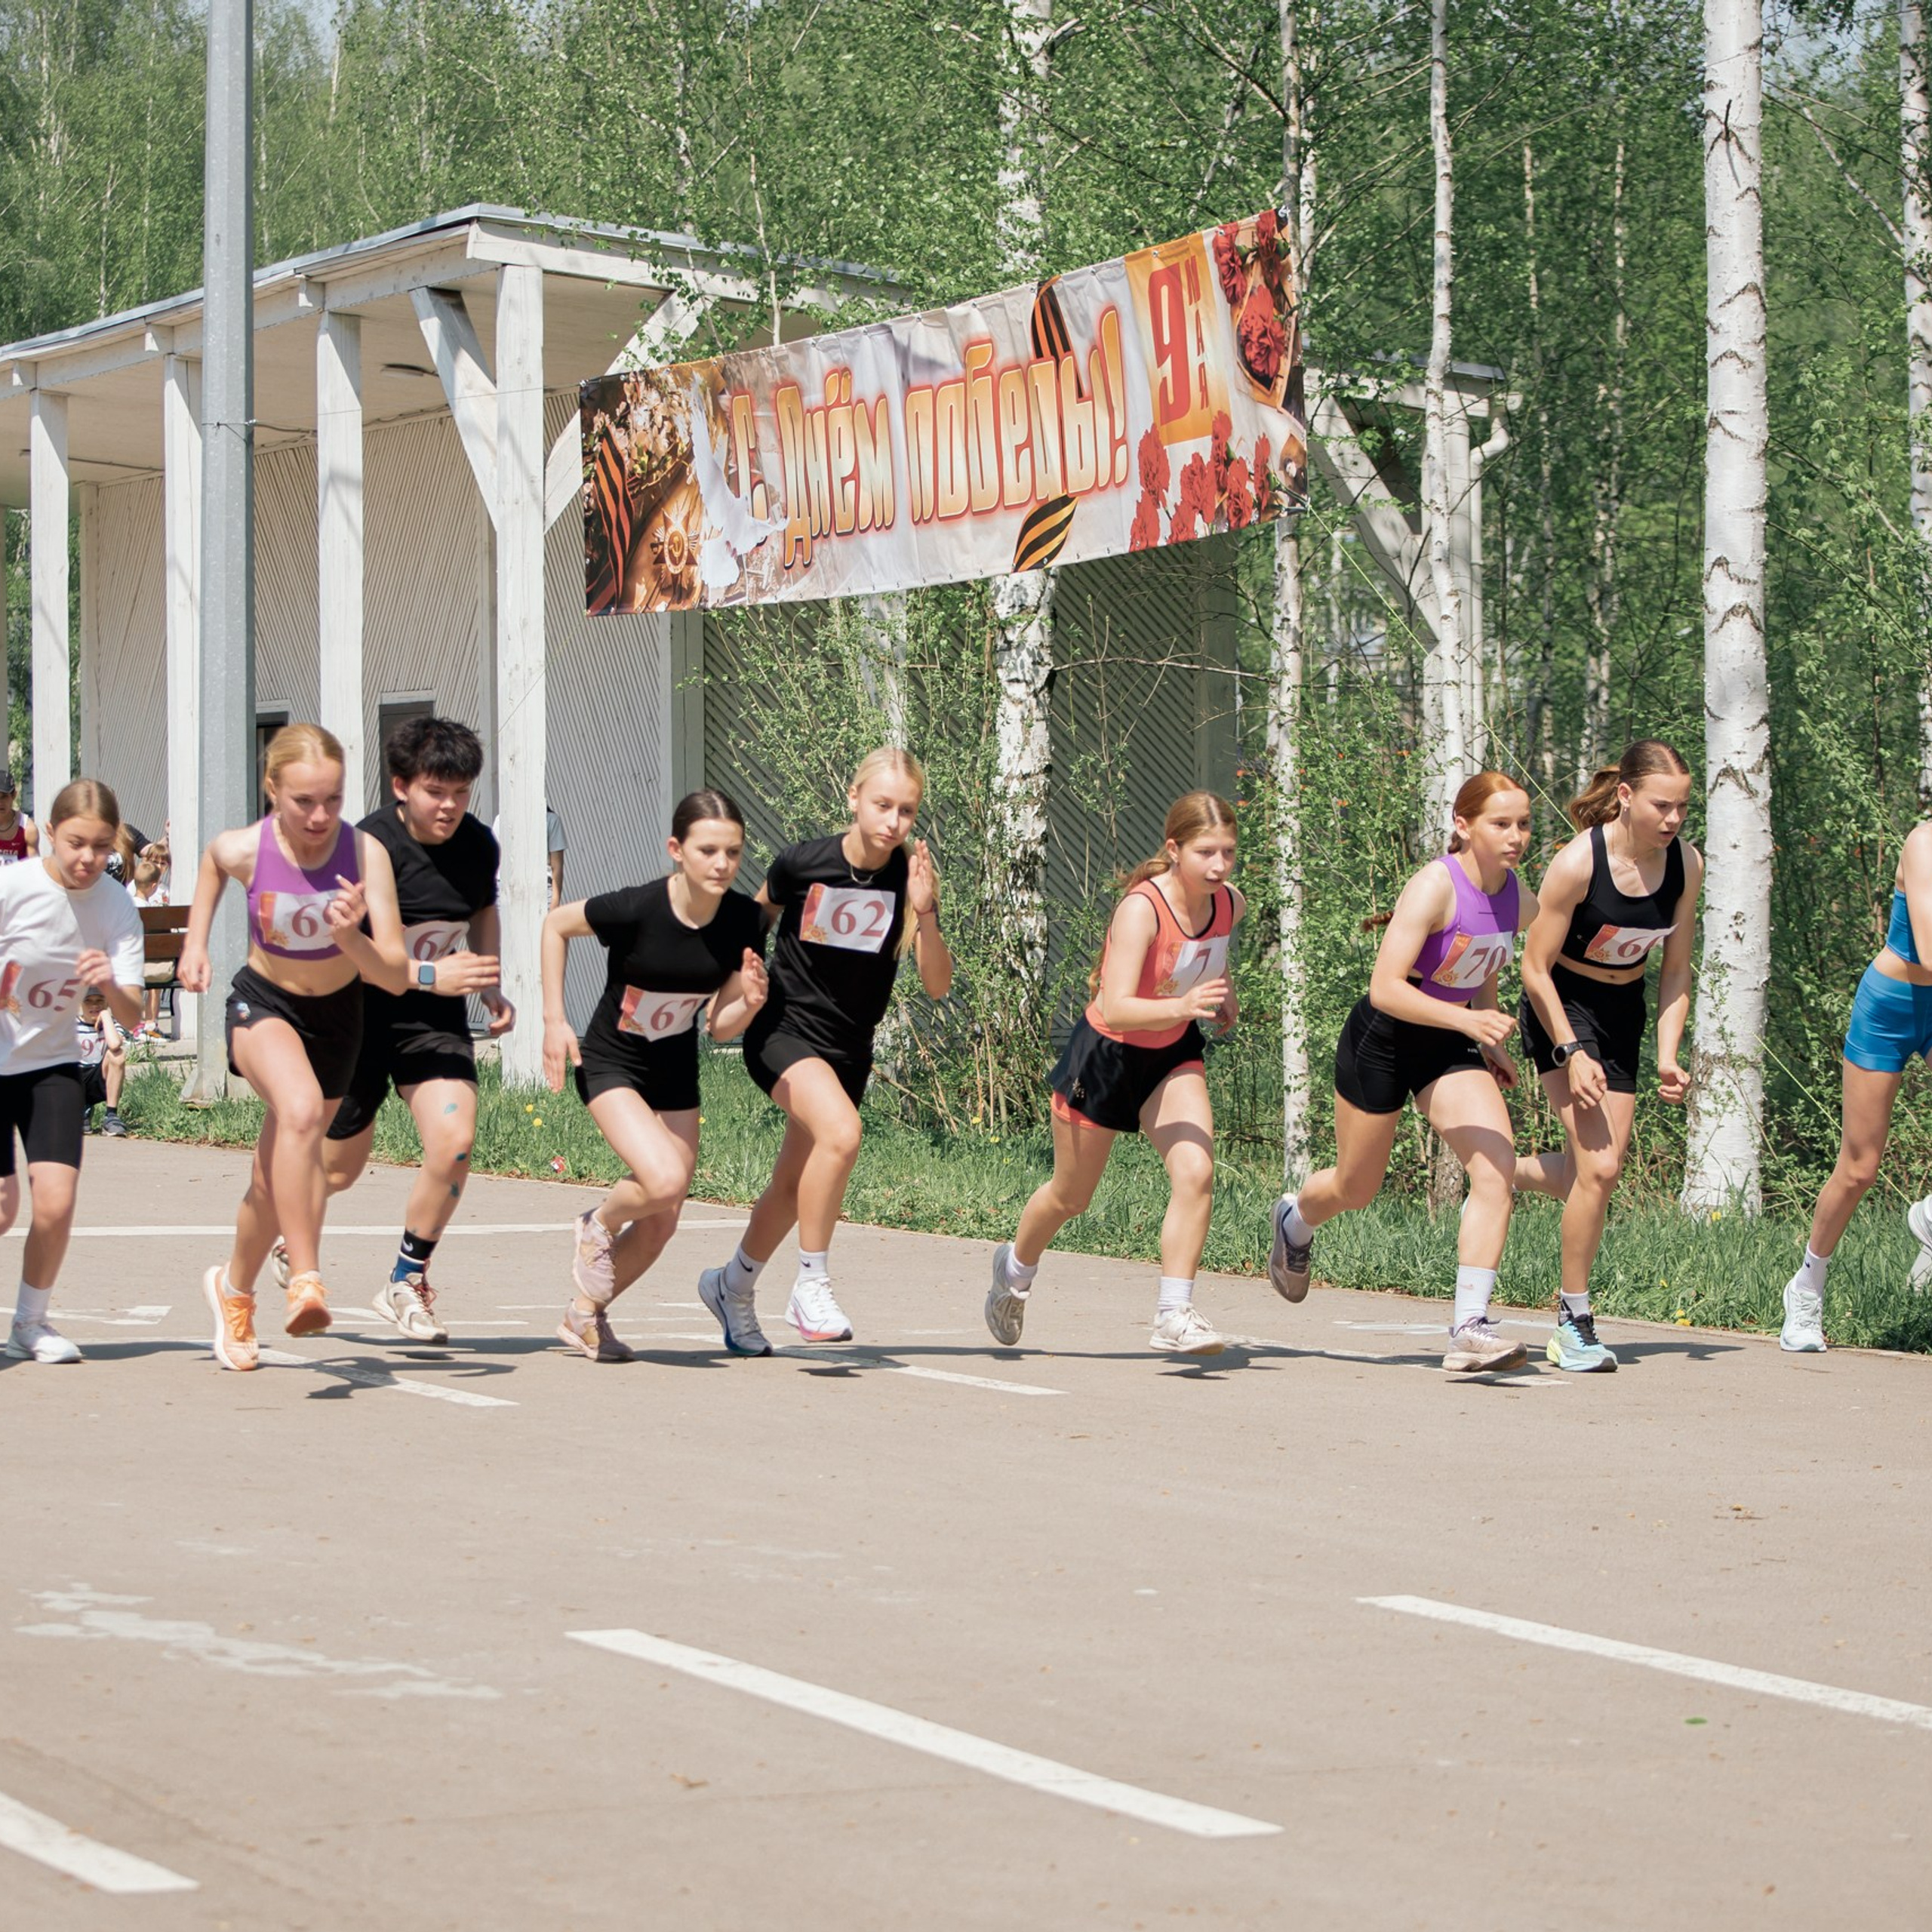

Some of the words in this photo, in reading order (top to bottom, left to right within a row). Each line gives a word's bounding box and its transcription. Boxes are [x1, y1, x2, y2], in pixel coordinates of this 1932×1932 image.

[1148, 262, 1191, 426] 9
[777, 368, 895, 570] Днём
[905, 306, 1128, 525] победы!
[831, 899, 886, 938] 62
[1463, 945, 1507, 980] 70
[28, 978, 83, 1012] 65
